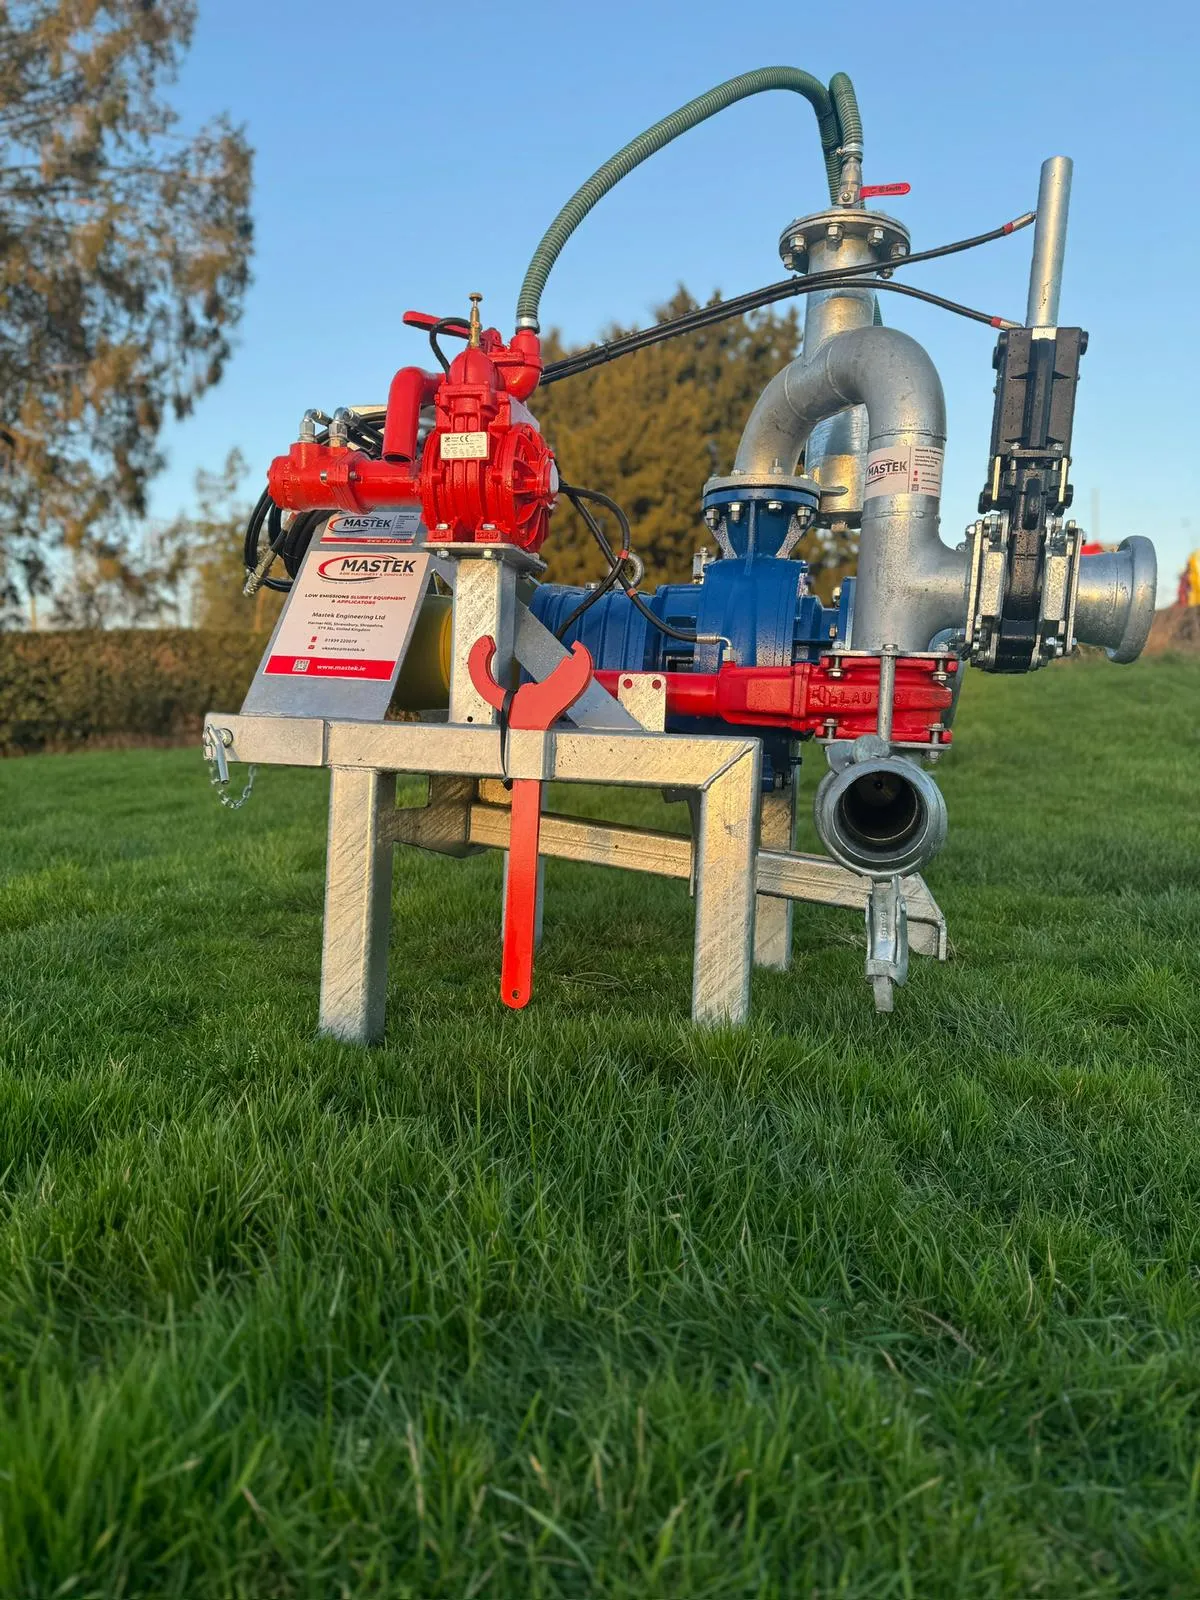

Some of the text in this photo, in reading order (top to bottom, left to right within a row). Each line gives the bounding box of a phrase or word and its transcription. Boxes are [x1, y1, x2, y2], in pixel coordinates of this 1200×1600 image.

[868, 461, 907, 476] MASTEK
[344, 519, 391, 528] MASTEK
[341, 560, 416, 573] MASTEK
